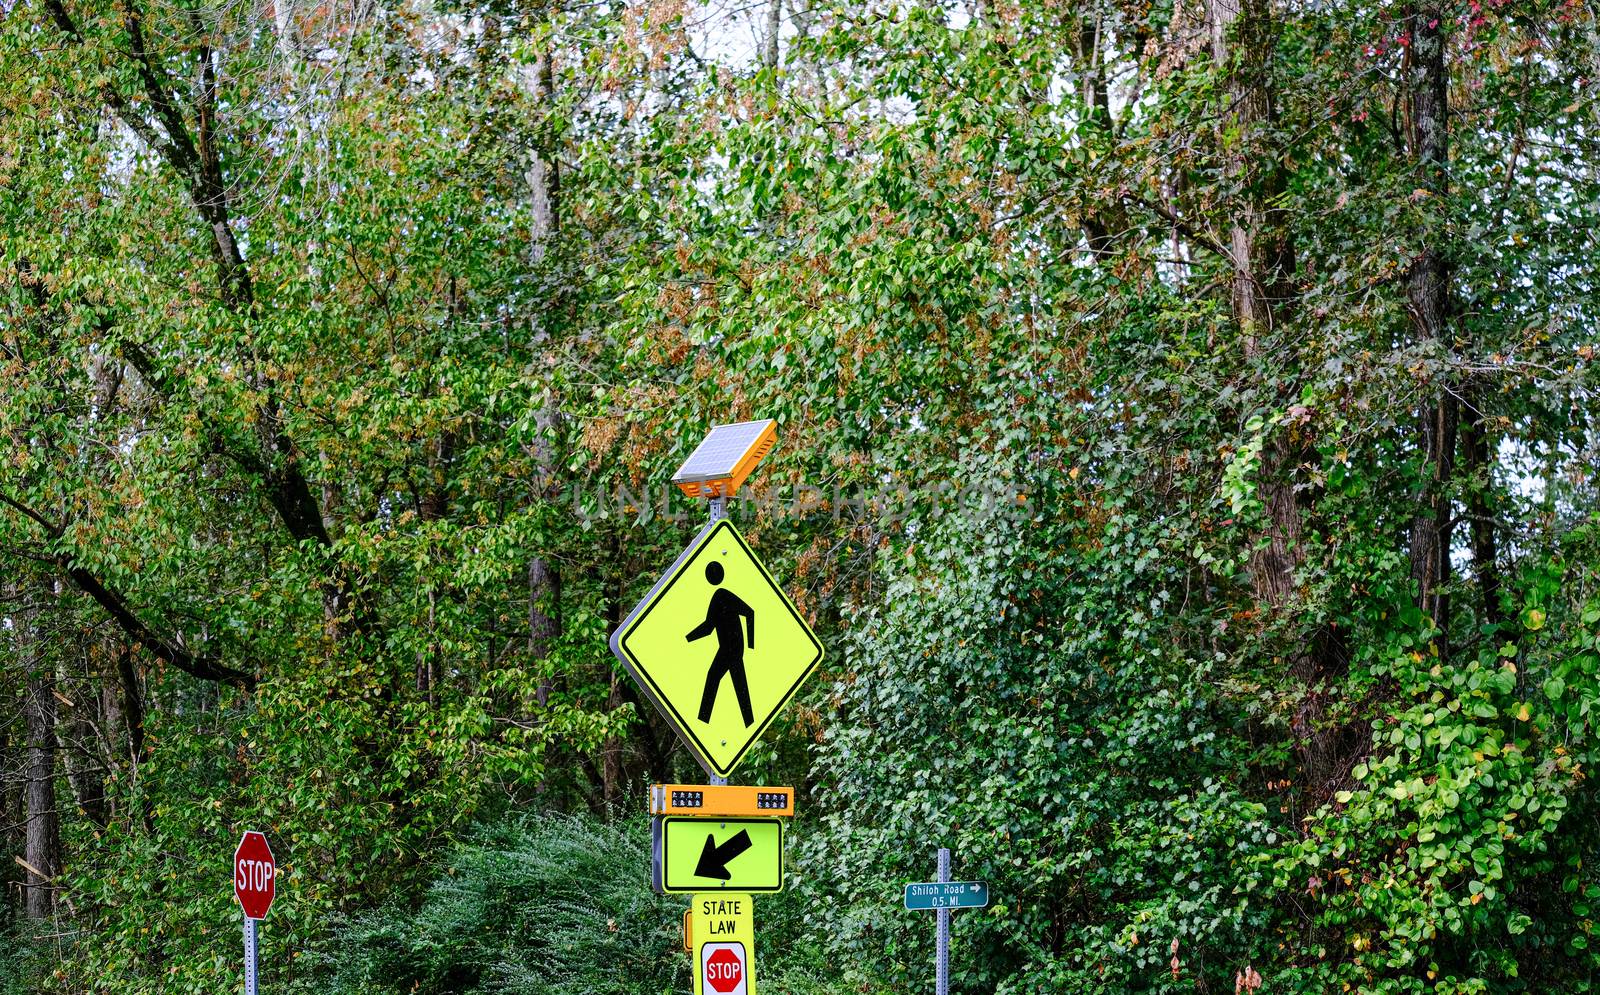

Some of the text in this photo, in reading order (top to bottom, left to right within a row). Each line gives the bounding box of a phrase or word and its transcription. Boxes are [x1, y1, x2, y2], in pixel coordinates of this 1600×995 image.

[238, 859, 272, 892] STOP
[912, 884, 965, 896] Shiloh Road
[703, 901, 742, 915] STATE
[709, 921, 736, 935] LAW
[708, 962, 740, 980] STOP
